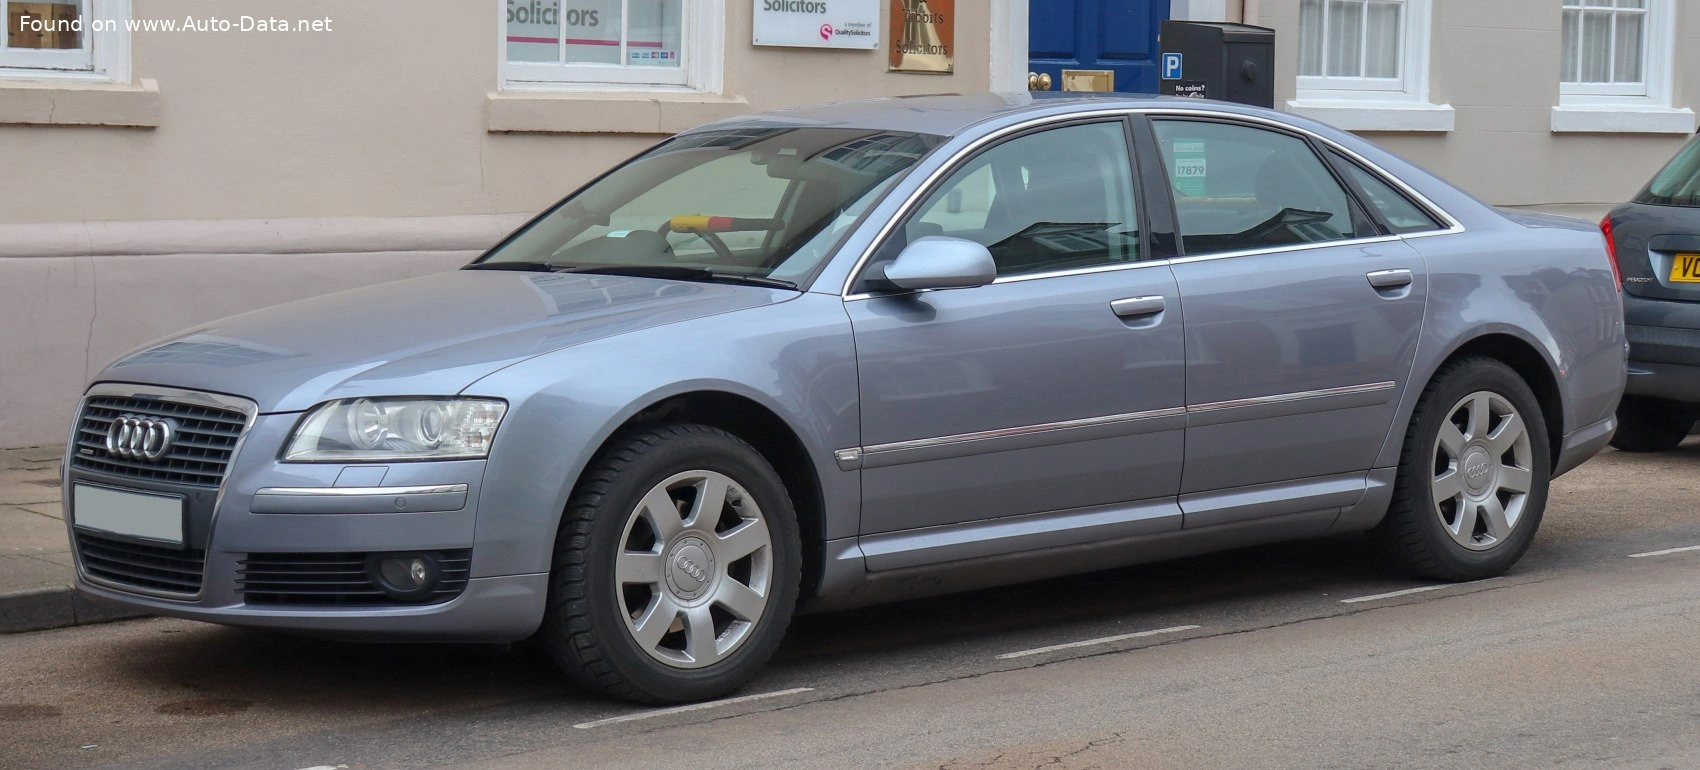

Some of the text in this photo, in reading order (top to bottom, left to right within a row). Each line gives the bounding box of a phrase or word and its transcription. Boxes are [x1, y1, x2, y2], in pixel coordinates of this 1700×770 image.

[506, 0, 599, 27] Soliciors
[764, 0, 827, 14] Solicitors
[895, 40, 948, 55] Solicitors
[1166, 56, 1179, 77] P
[1185, 84, 1206, 92] coins?
[1177, 166, 1205, 176] 17879
